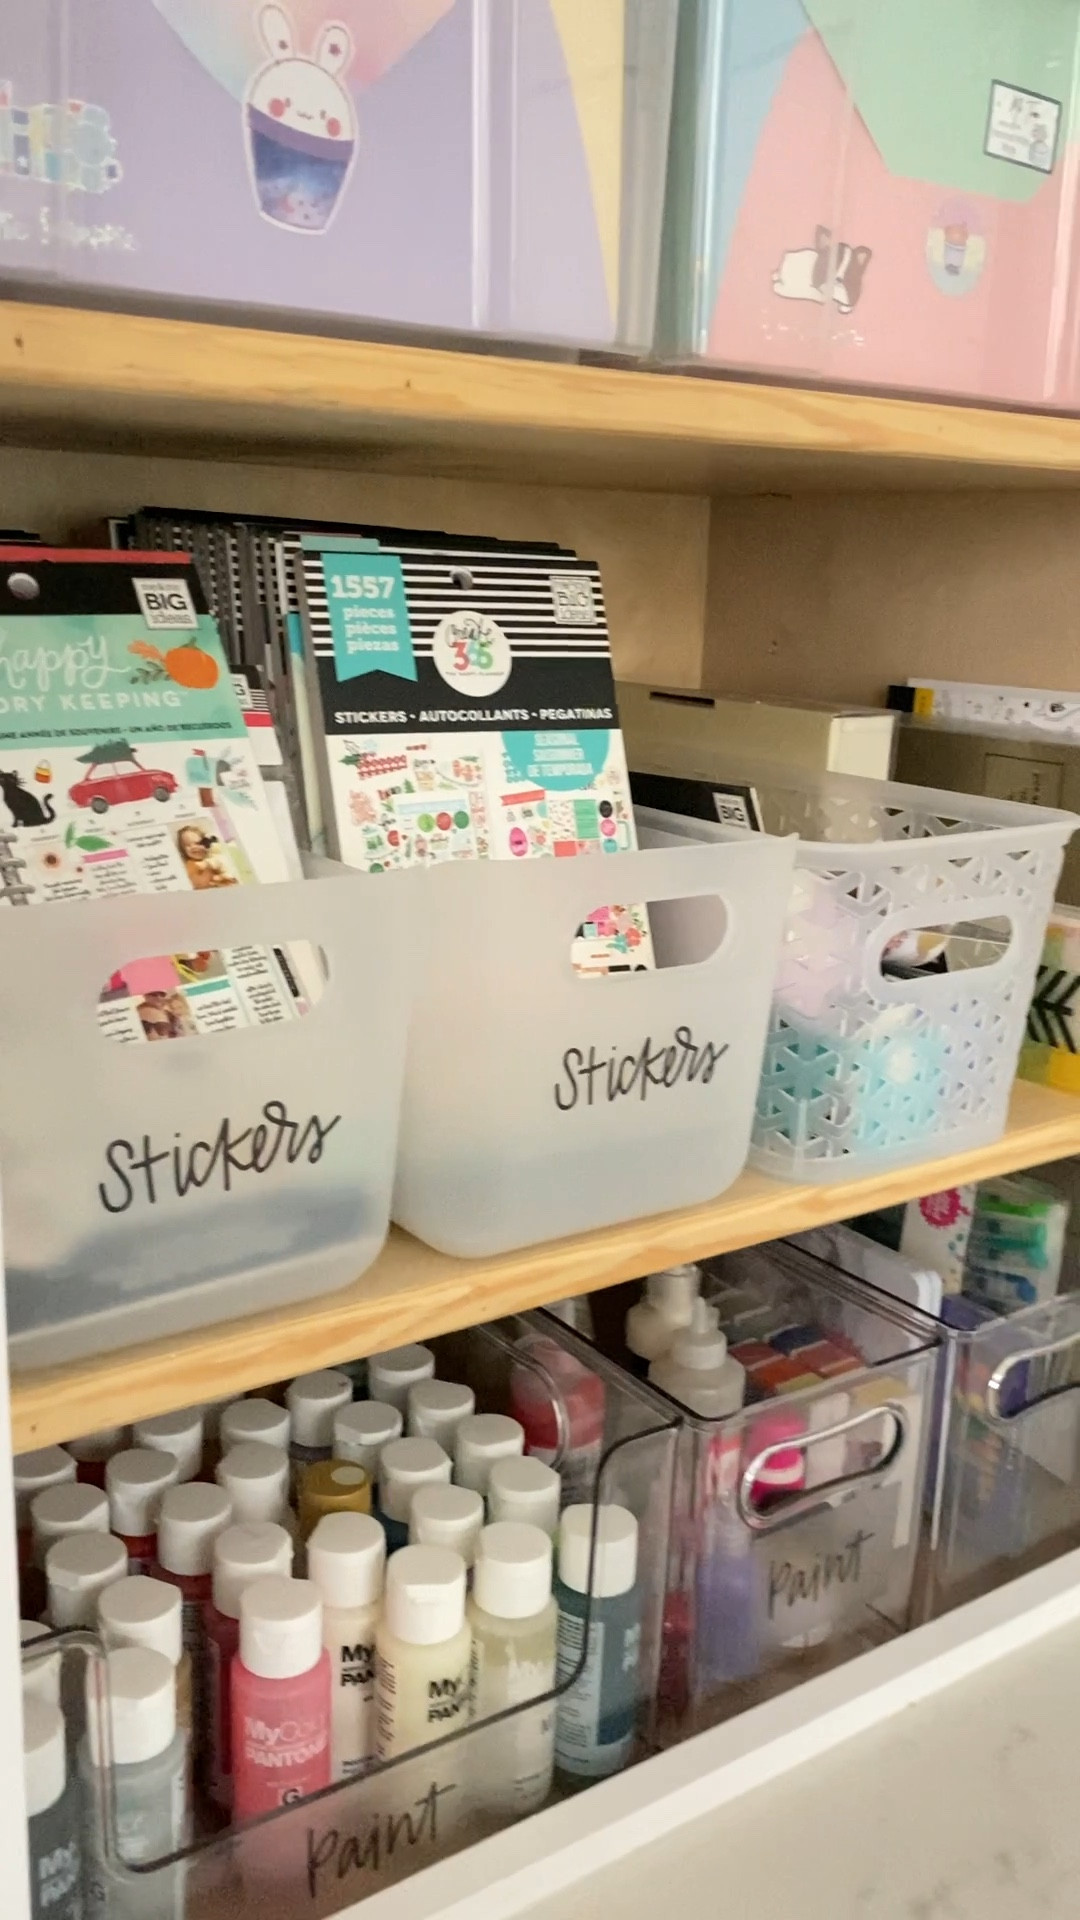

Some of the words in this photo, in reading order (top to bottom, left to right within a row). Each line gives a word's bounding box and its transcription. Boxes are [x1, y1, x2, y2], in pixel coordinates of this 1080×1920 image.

[331, 575, 395, 599] 1557
[144, 592, 188, 610] BIG
[342, 605, 395, 620] pieces
[344, 621, 397, 637] pièces
[346, 638, 399, 654] piezas
[452, 640, 494, 671] 365
[60, 690, 181, 711] KEEPING
[334, 710, 408, 724] STICKERS
[419, 709, 530, 722] AUTOCOLLANTS
[539, 707, 613, 720] PEGATINAS
[553, 1026, 731, 1111] Stickers
[99, 1100, 342, 1212] Stickers
